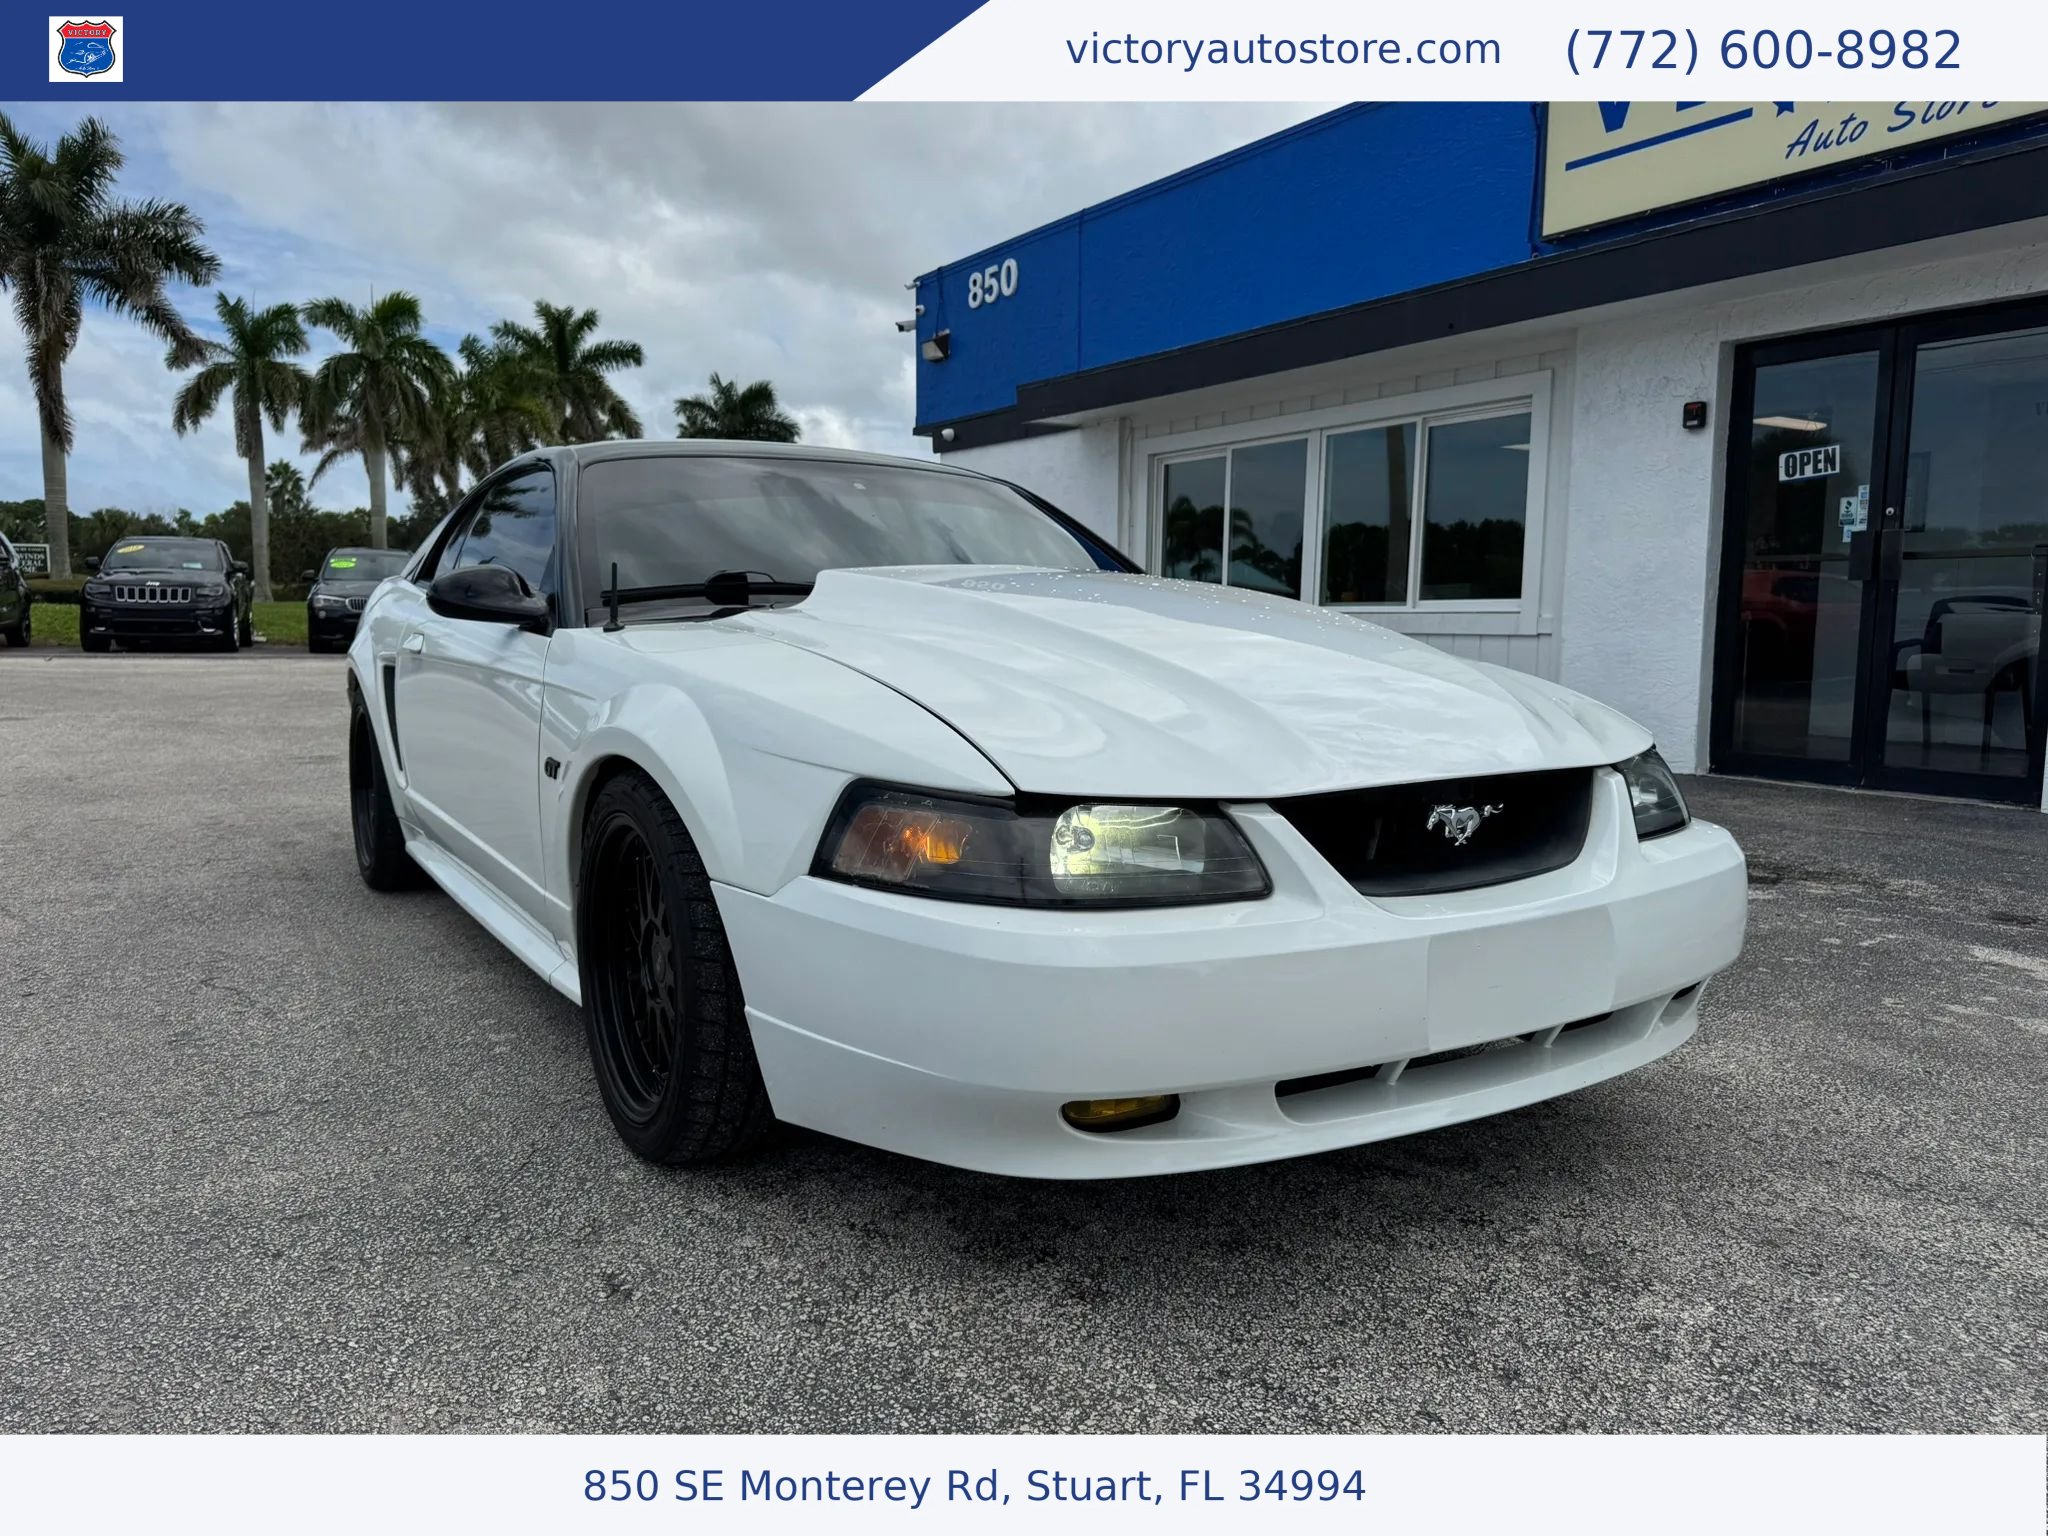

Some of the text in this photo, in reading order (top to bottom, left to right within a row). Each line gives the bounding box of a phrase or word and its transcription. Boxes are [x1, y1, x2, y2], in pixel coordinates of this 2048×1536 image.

[1785, 112, 1869, 159] Auto
[968, 258, 1018, 309] 850
[1784, 447, 1836, 478] OPEN
